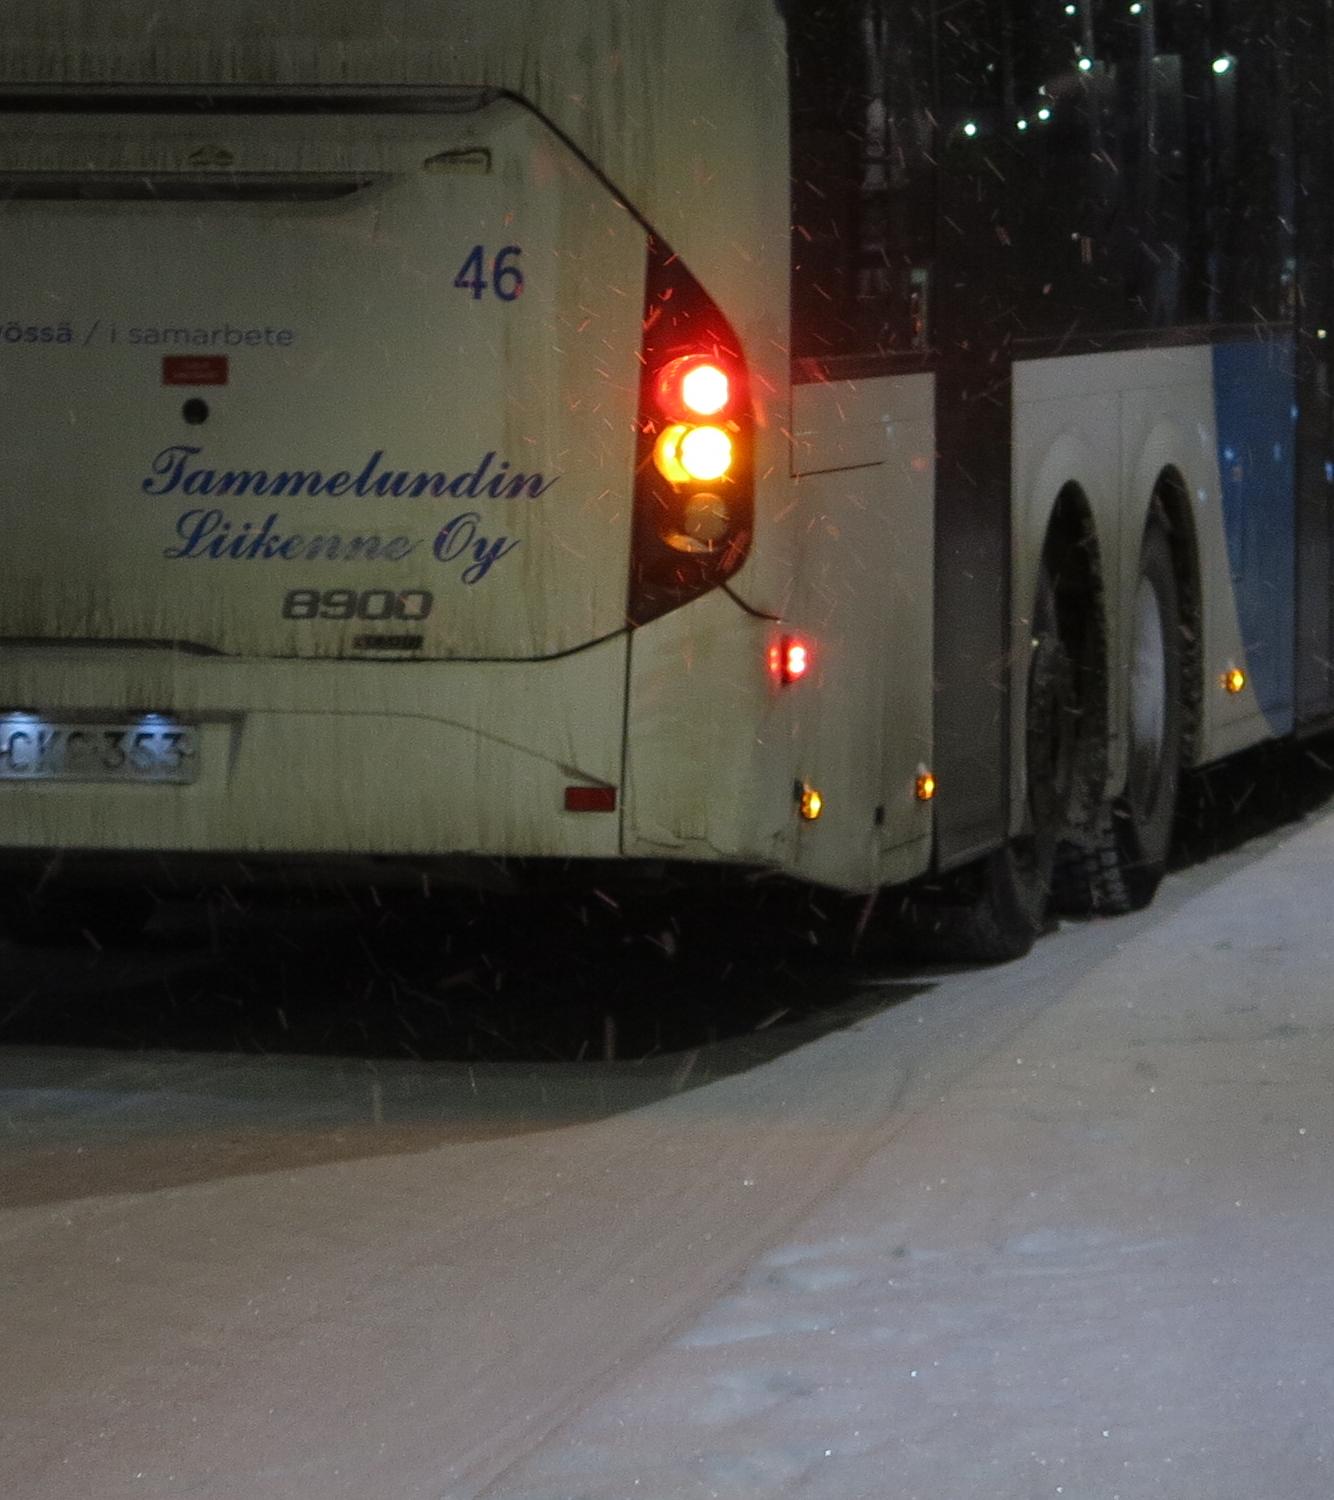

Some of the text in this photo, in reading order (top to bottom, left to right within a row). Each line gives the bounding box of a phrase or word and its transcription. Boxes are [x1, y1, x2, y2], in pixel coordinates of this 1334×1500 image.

[453, 245, 524, 301] 46
[81, 319, 101, 347] /
[128, 322, 294, 347] samarbete
[141, 445, 559, 500] Tammelundin
[163, 508, 521, 585] Liikenne Oy
[282, 588, 434, 620] 8900
